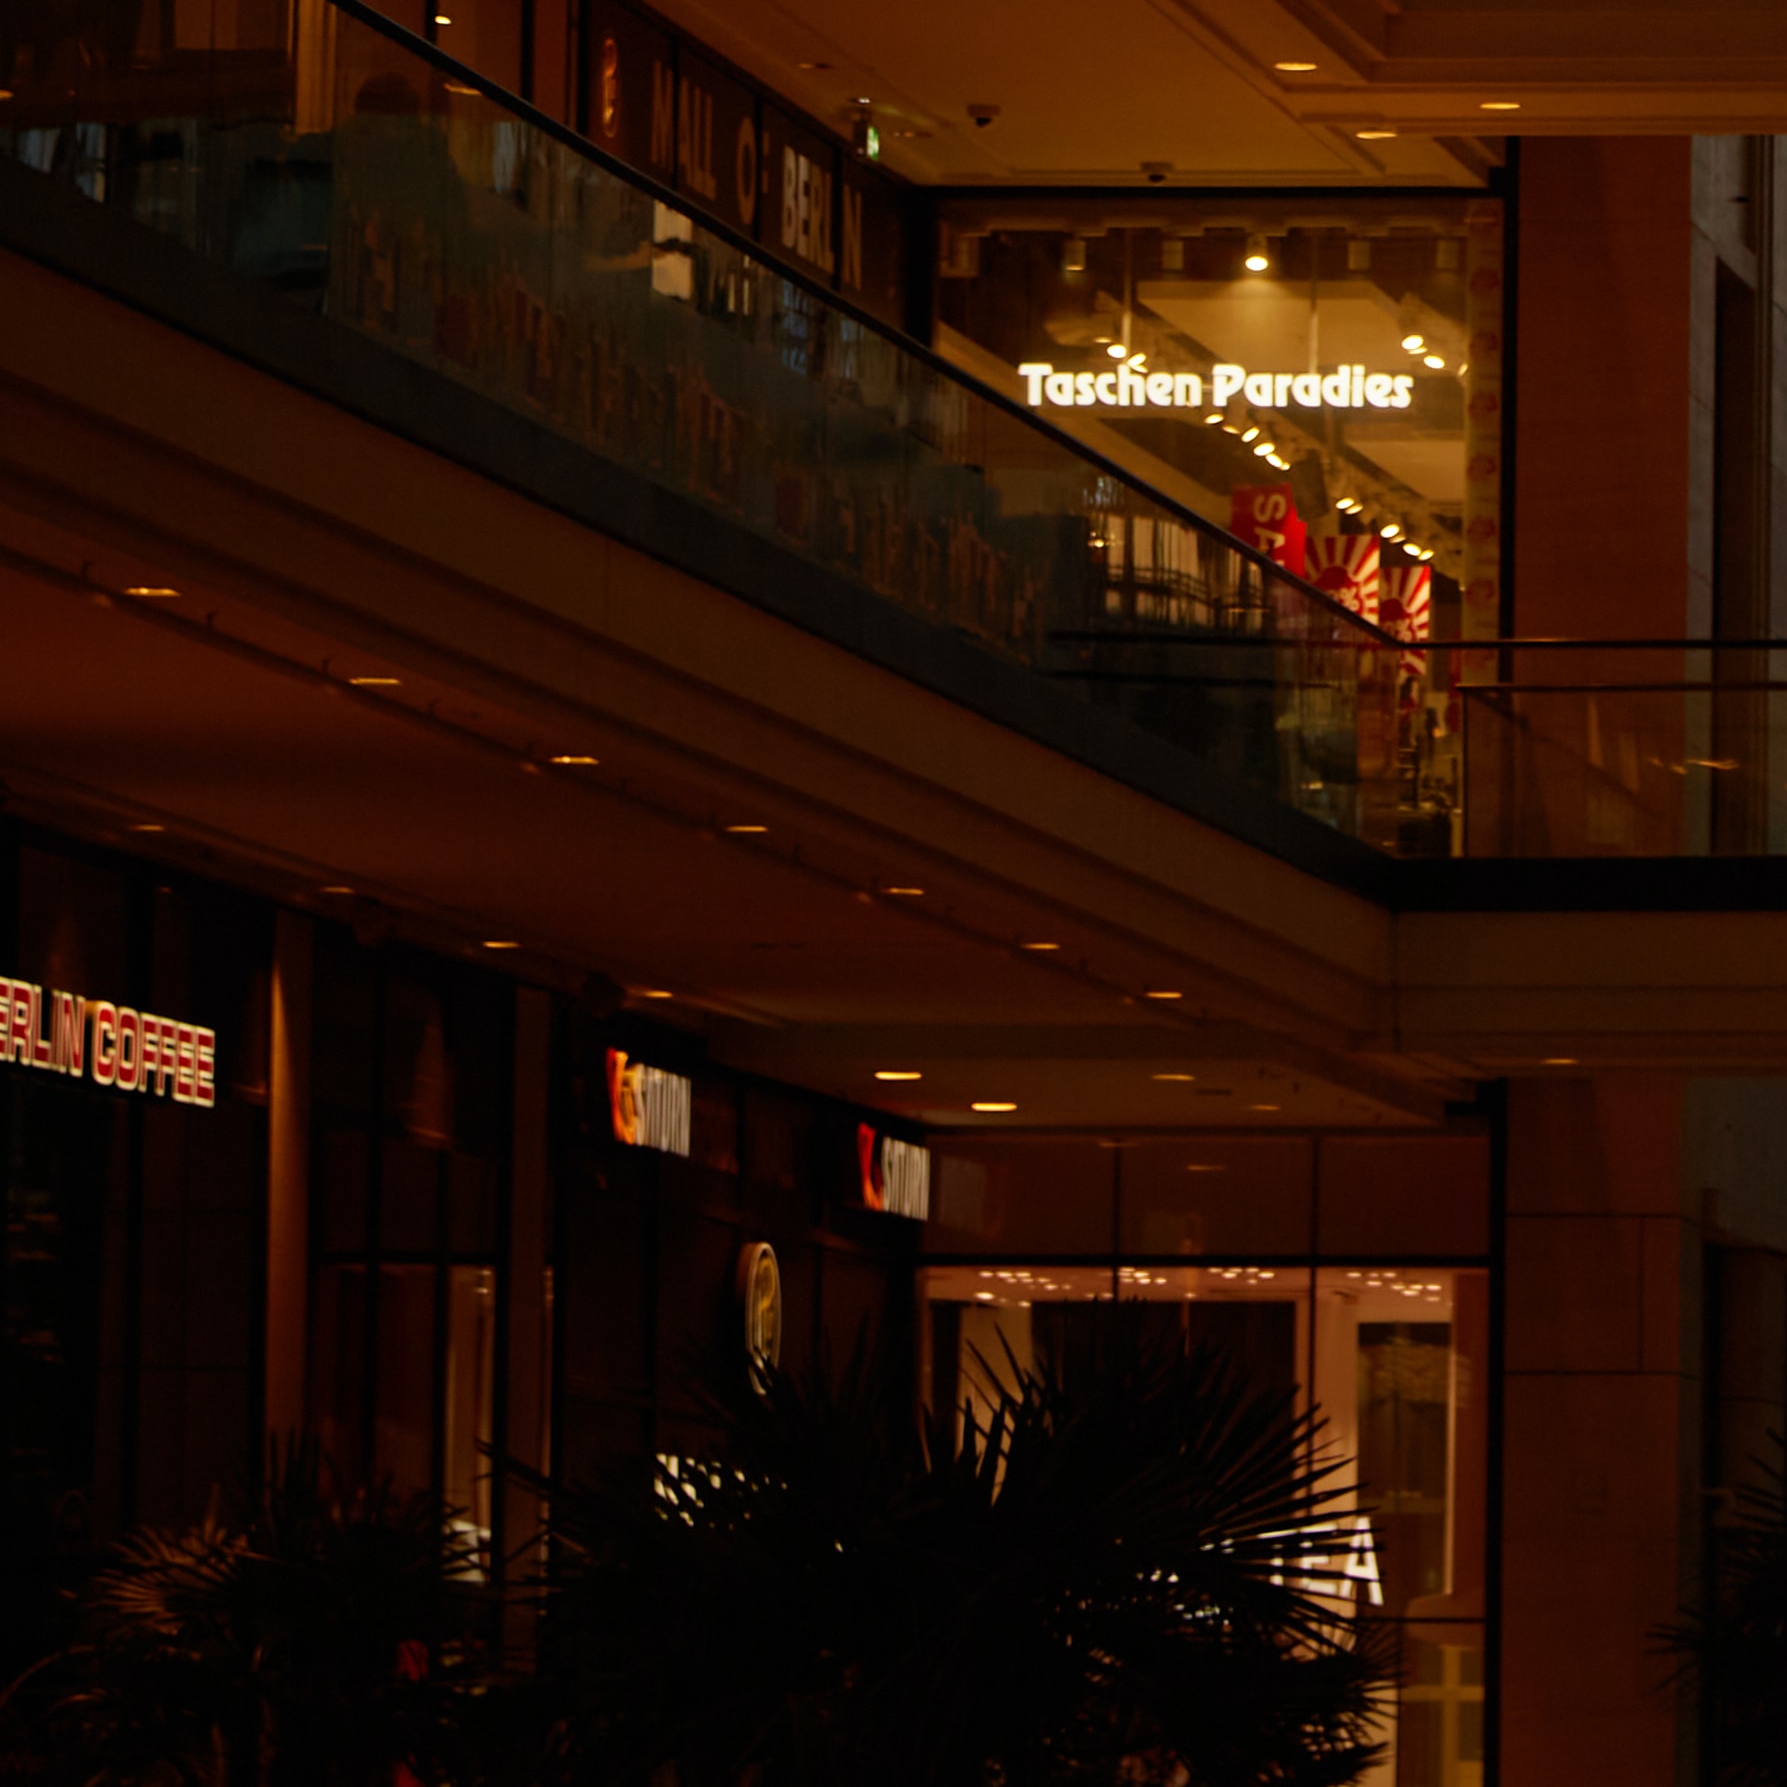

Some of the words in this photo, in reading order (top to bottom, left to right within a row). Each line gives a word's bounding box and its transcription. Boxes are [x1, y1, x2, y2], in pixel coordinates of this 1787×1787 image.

[781, 144, 862, 292] BERLN
[1018, 363, 1202, 407] Taschen
[1212, 364, 1413, 409] Paradies
[92, 999, 215, 1108] COFFEE
